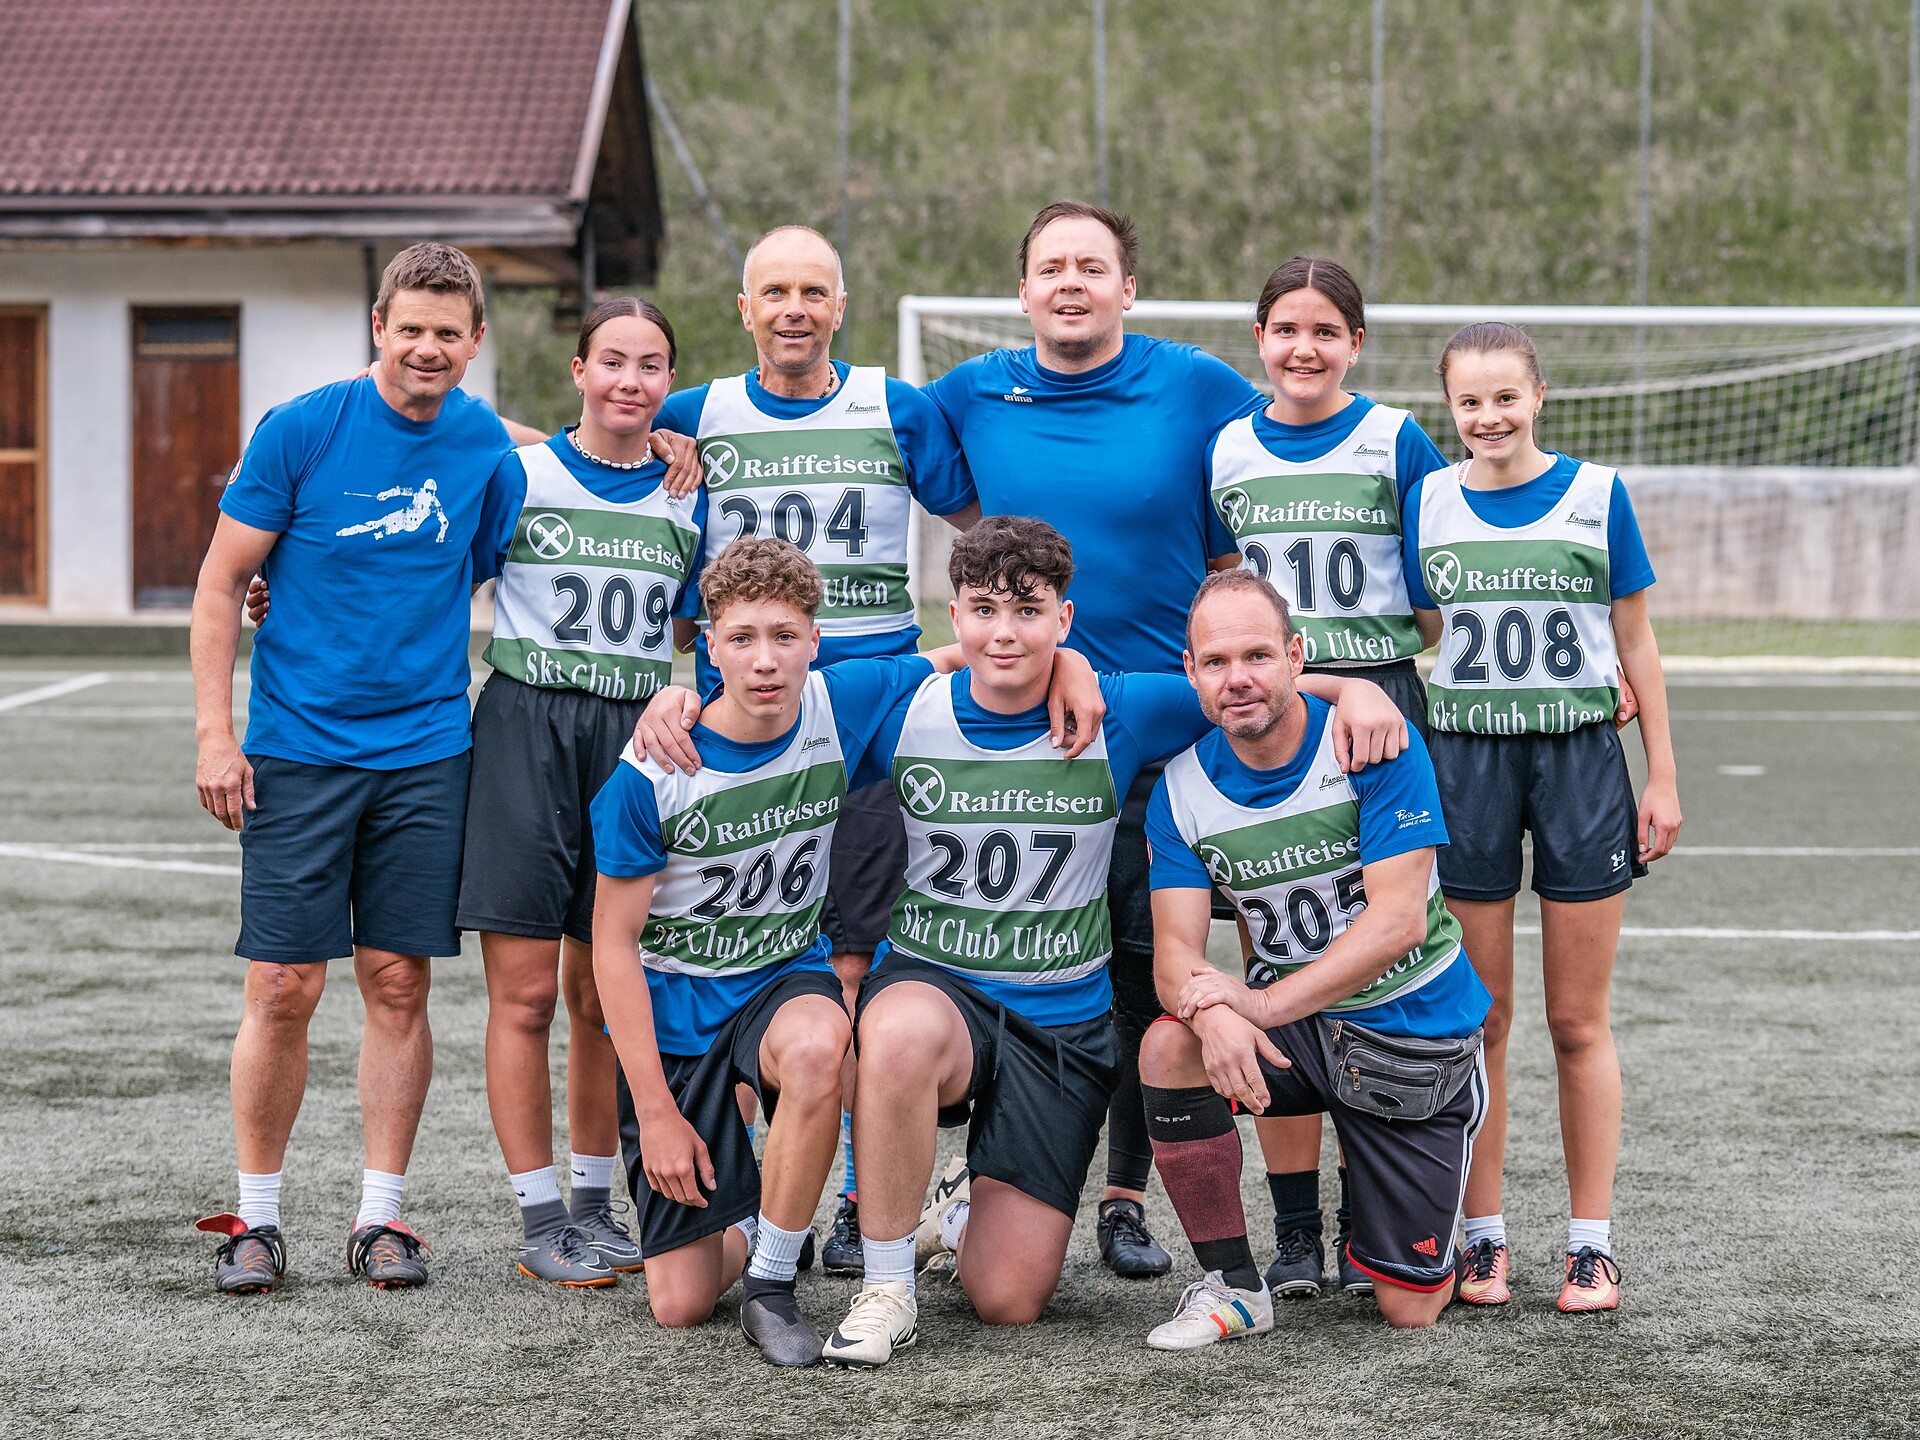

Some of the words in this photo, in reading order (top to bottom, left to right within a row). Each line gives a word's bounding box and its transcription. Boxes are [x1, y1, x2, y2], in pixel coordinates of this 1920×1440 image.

[1003, 393, 1033, 403] erima
[741, 454, 891, 479] Raiffeisen
[718, 487, 869, 558] 204
[1250, 500, 1388, 525] Raiffeisen
[577, 536, 685, 573] Raiffeise
[823, 575, 889, 607] Ulten
[1464, 567, 1594, 593] Raiffeisen
[551, 572, 671, 651] 209
[1324, 628, 1397, 659] Ulten
[1450, 606, 1585, 684] 208
[525, 651, 565, 685] Ski
[1467, 701, 1527, 735] Club
[948, 789, 1103, 814] Raiffeisen
[714, 795, 839, 846] Raiffeisen
[926, 829, 1077, 905] 207
[1233, 836, 1360, 882] Raiffeise
[690, 836, 822, 920] 206
[900, 902, 933, 945] Ski
[938, 918, 1000, 960] Club
[1012, 922, 1081, 961] Ulten
[1412, 1243, 1439, 1256] adidas
